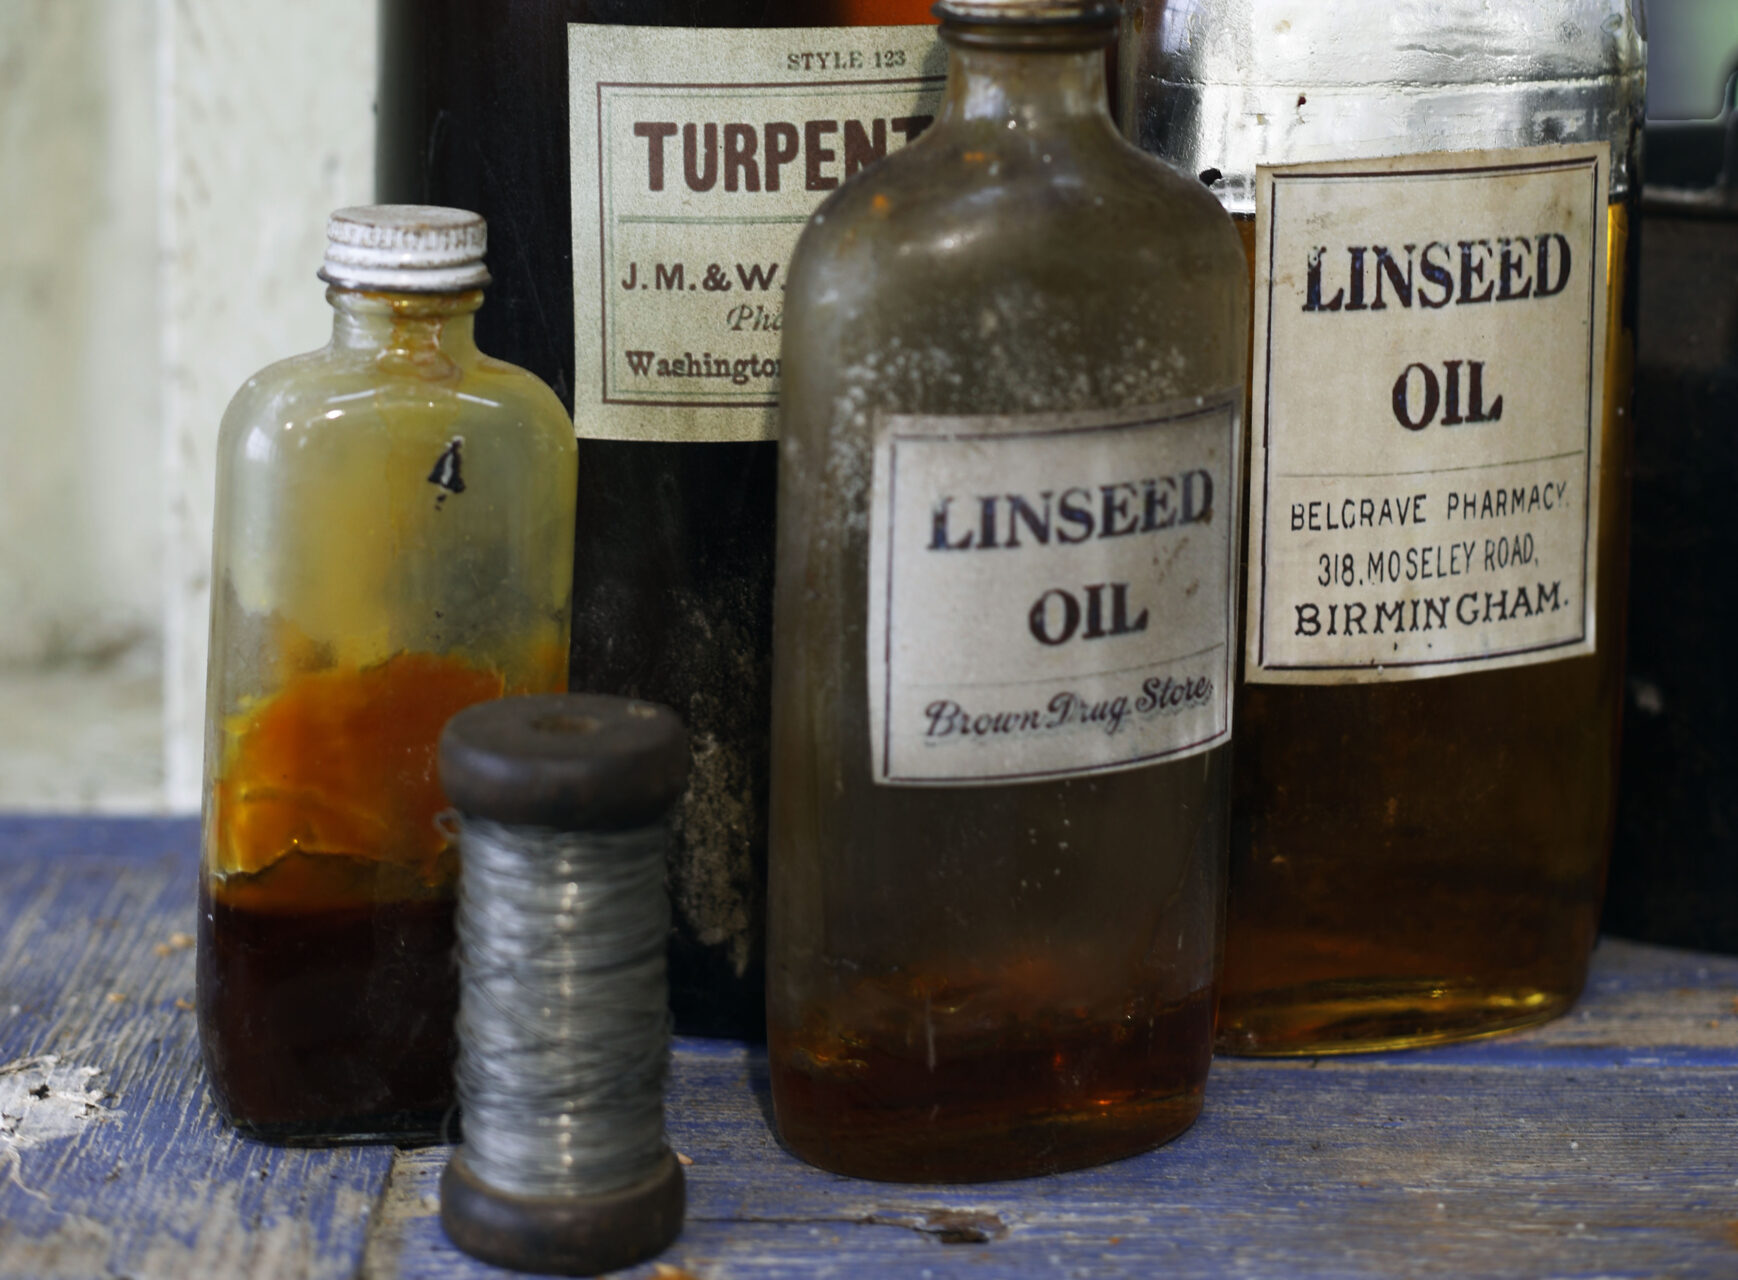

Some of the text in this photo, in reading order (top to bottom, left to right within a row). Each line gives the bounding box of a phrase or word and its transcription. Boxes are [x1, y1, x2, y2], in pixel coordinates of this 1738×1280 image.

[787, 49, 906, 70] STYLE 123
[1302, 233, 1573, 312] LINSEED
[1392, 360, 1503, 431] OIL
[926, 469, 1215, 551] LINSEED
[1291, 493, 1427, 531] BELGRAVE
[1028, 583, 1149, 646] OIL
[1295, 580, 1569, 636] BIRMINGHAM.
[924, 700, 1041, 738] Brown
